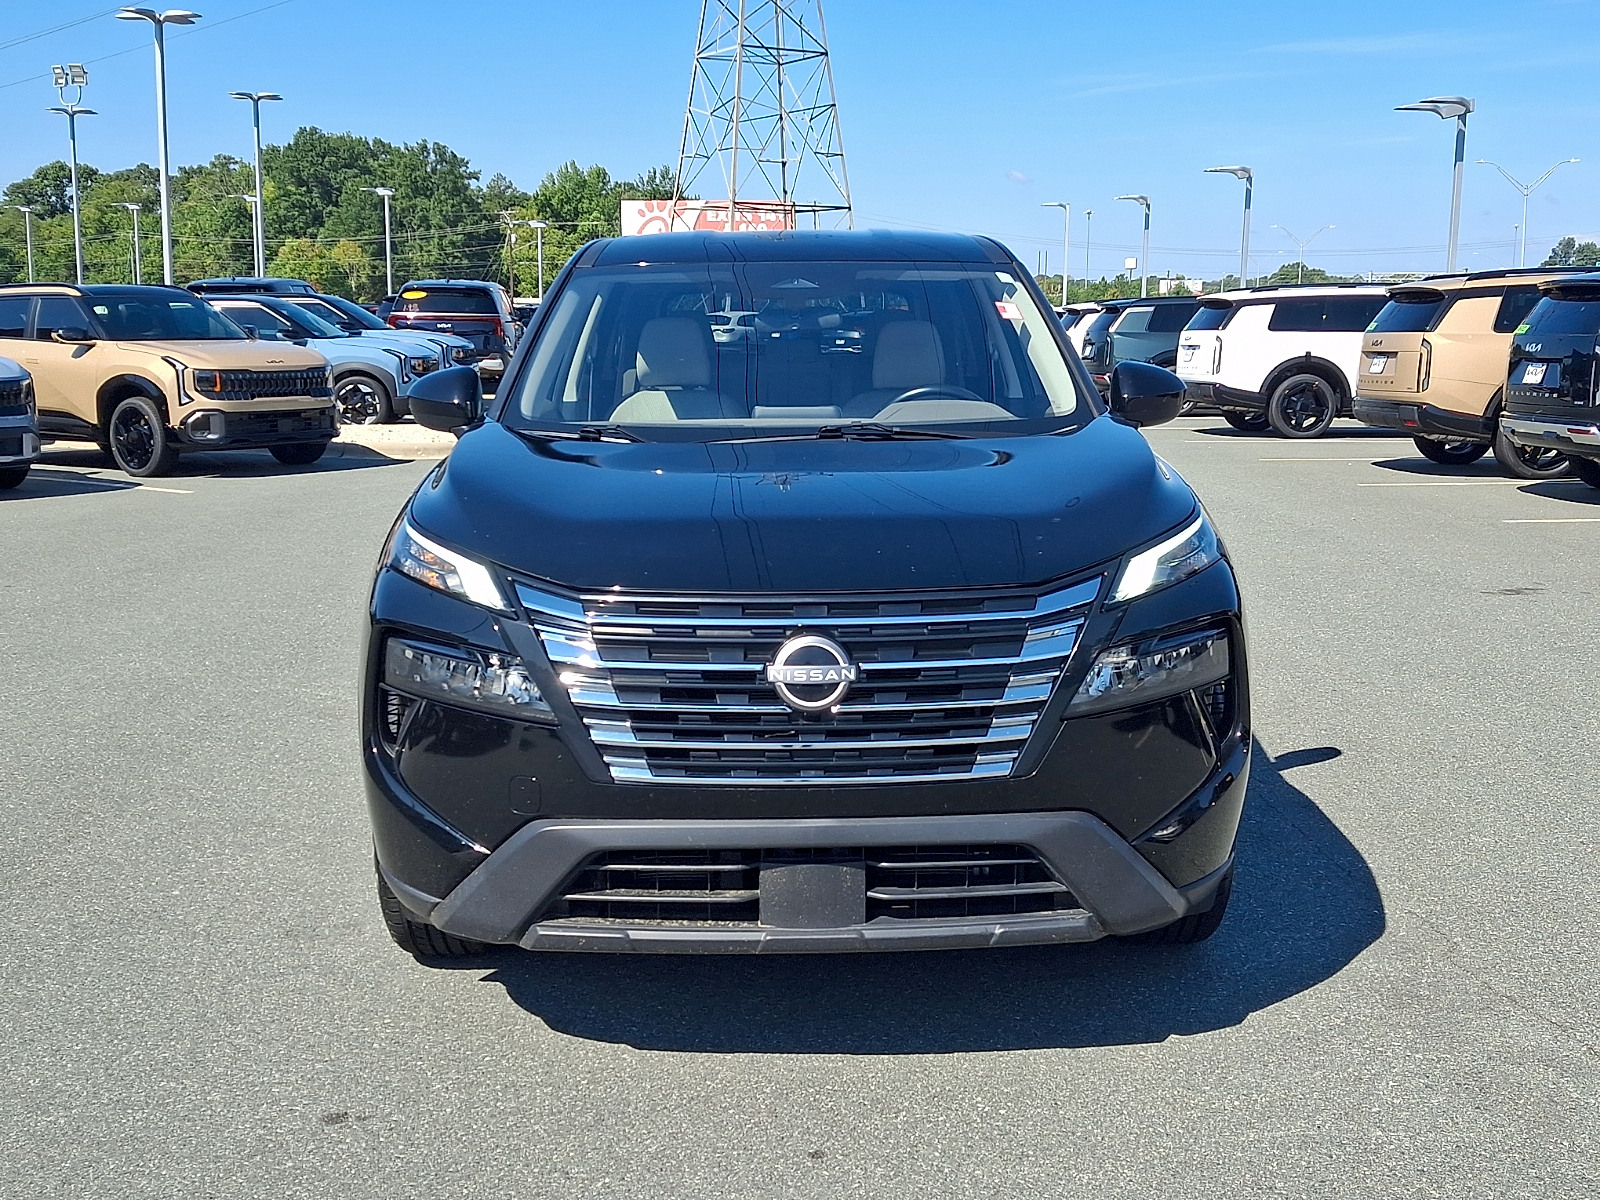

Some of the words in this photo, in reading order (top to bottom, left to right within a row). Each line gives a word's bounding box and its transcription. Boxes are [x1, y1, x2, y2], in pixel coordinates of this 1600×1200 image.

[706, 210, 752, 222] EXTS
[1525, 342, 1543, 352] KIA
[768, 667, 856, 682] NISSAN
